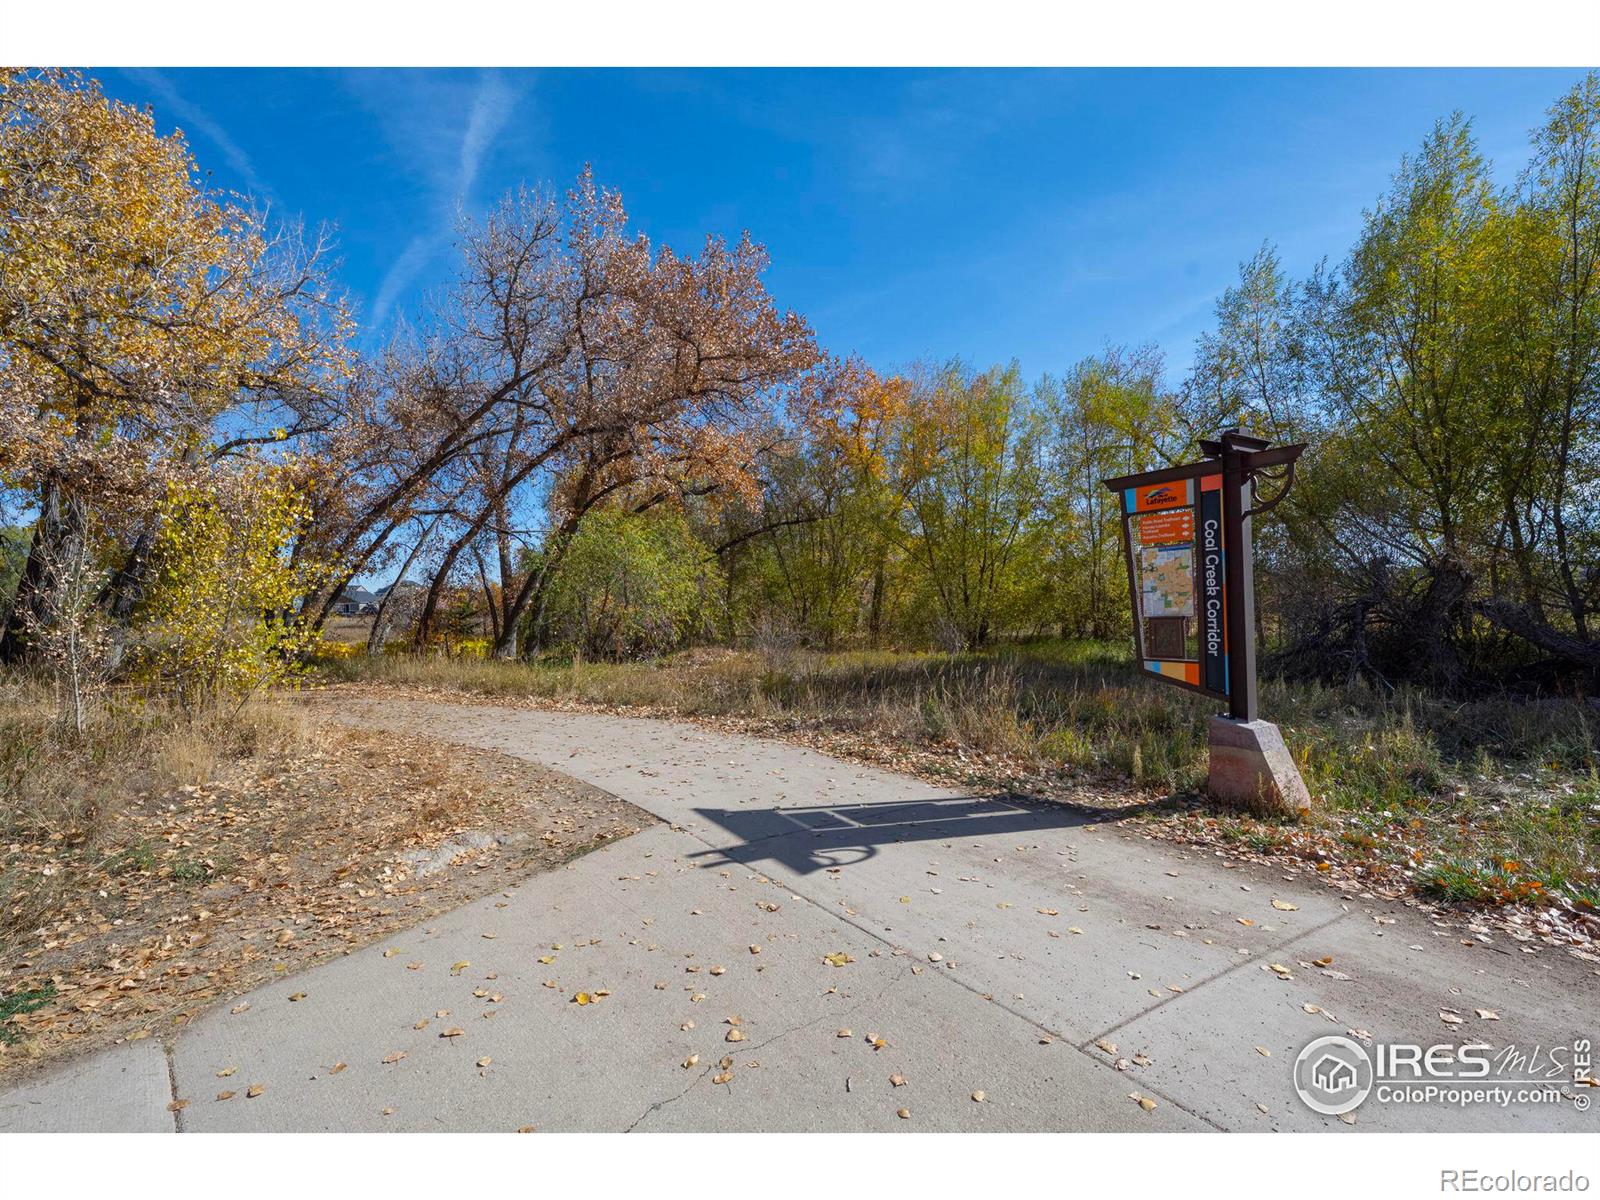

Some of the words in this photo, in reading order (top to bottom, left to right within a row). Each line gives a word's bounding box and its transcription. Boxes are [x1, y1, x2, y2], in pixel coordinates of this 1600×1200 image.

[1145, 495, 1178, 506] Lafayette
[1204, 519, 1219, 551] Coal
[1205, 554, 1220, 596] Creek
[1206, 599, 1222, 657] Corridor
